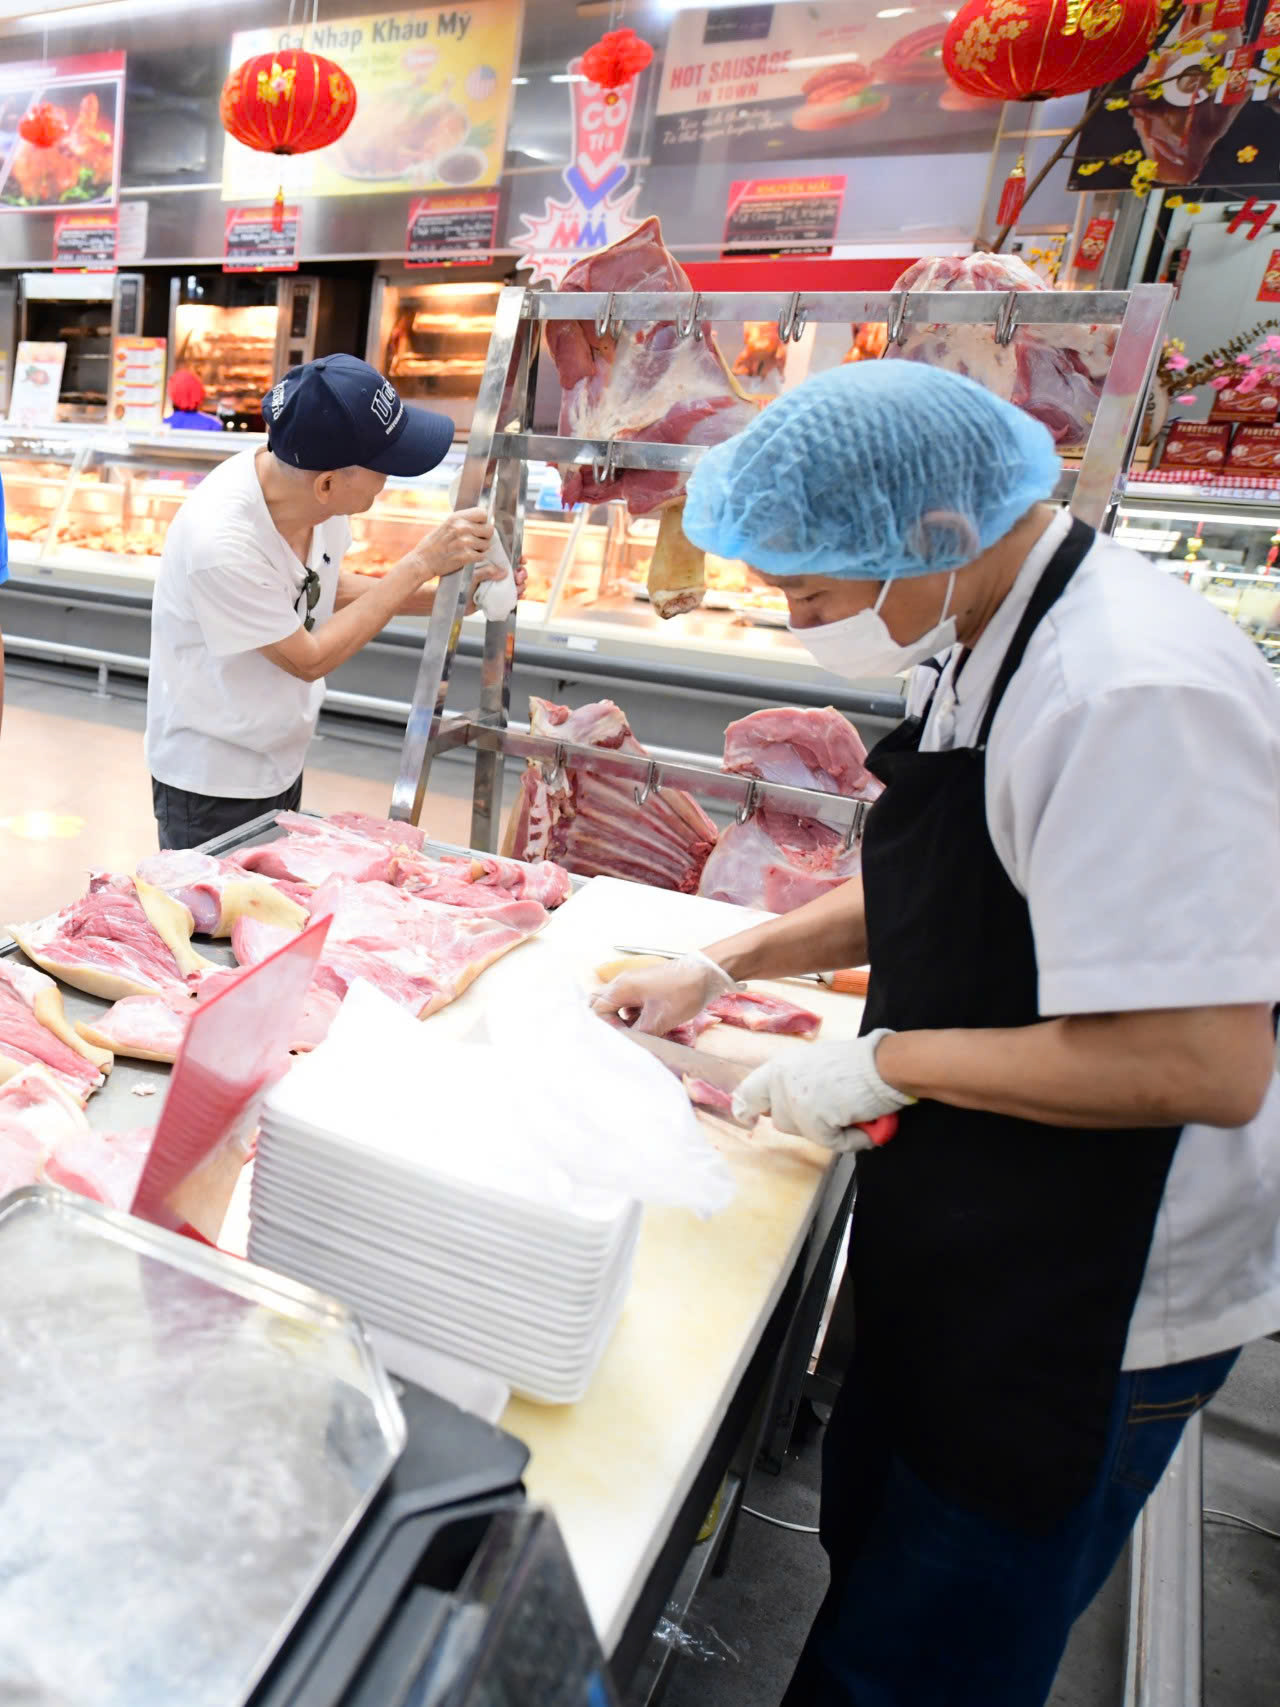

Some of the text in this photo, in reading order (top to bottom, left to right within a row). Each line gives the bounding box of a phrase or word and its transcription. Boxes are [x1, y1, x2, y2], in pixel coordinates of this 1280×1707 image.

[671, 64, 706, 89] HOT
[696, 83, 760, 105] IN TOWN
[1200, 486, 1265, 499] CHEESE
